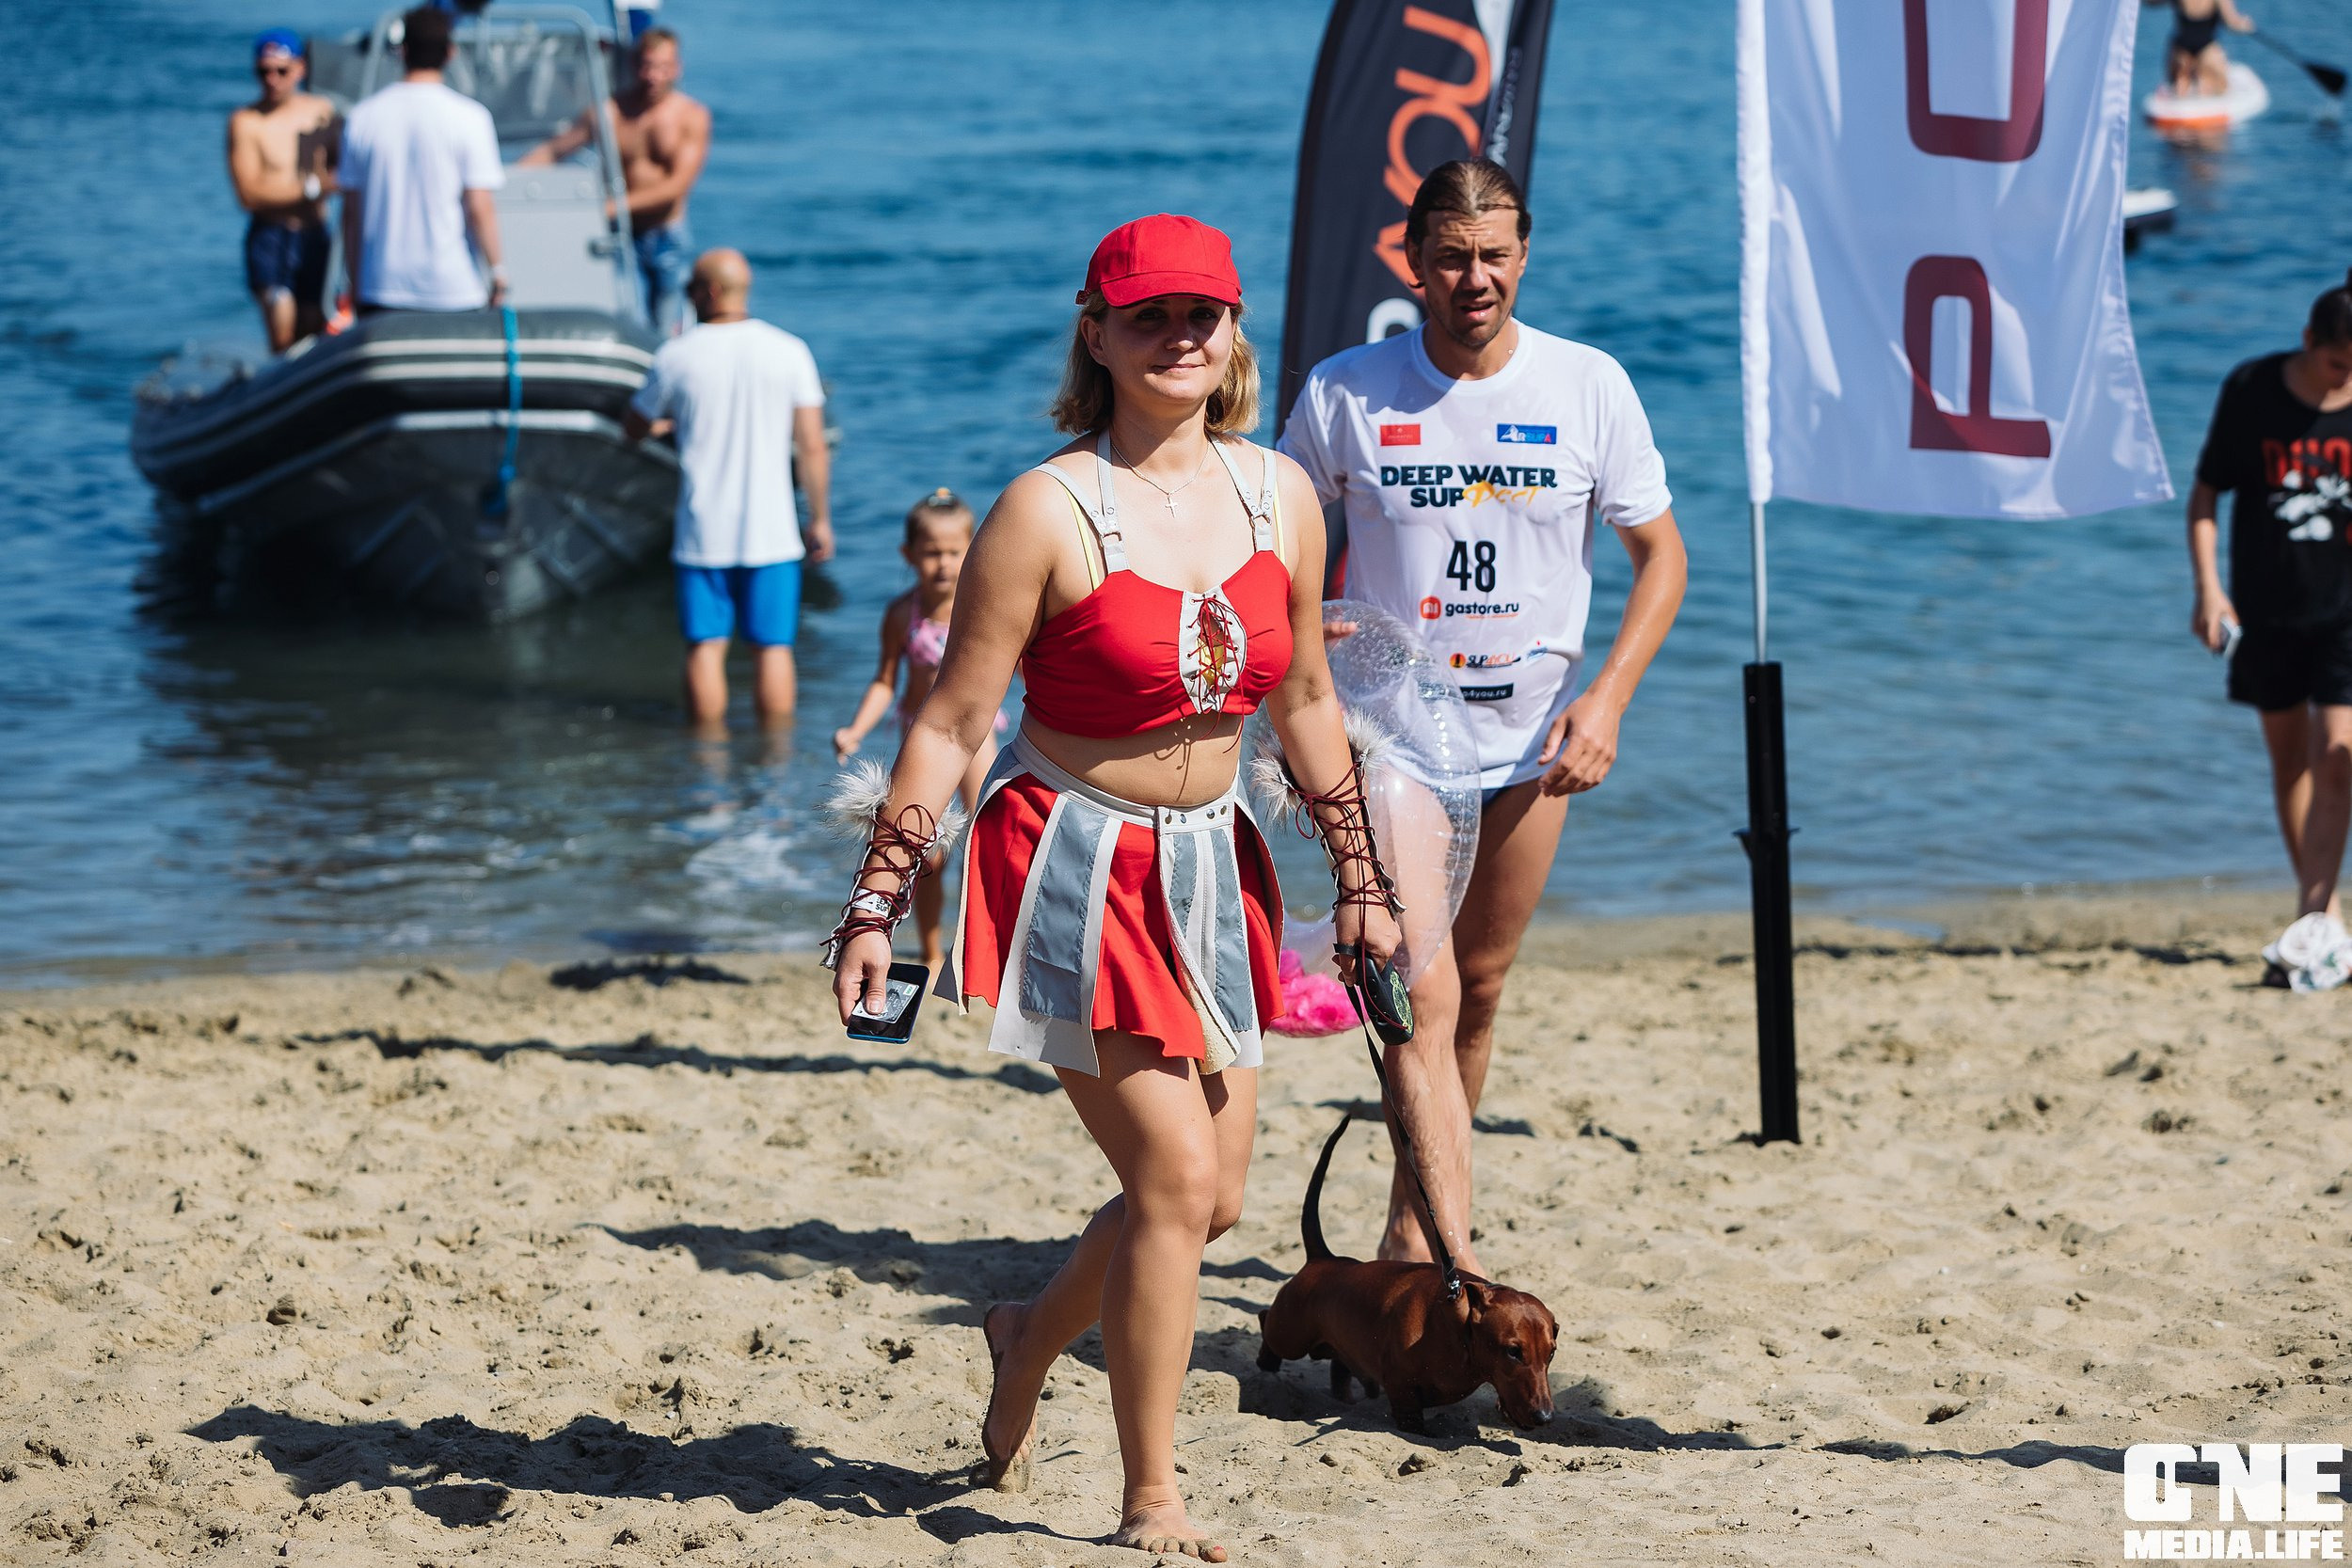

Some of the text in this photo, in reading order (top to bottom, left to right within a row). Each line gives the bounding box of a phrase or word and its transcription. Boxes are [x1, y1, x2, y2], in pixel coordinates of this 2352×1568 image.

[1380, 465, 1558, 488] DEEP WATER
[1410, 486, 1465, 508] SUP
[1446, 541, 1497, 593] 48
[1445, 602, 1519, 617] gastore.ru
